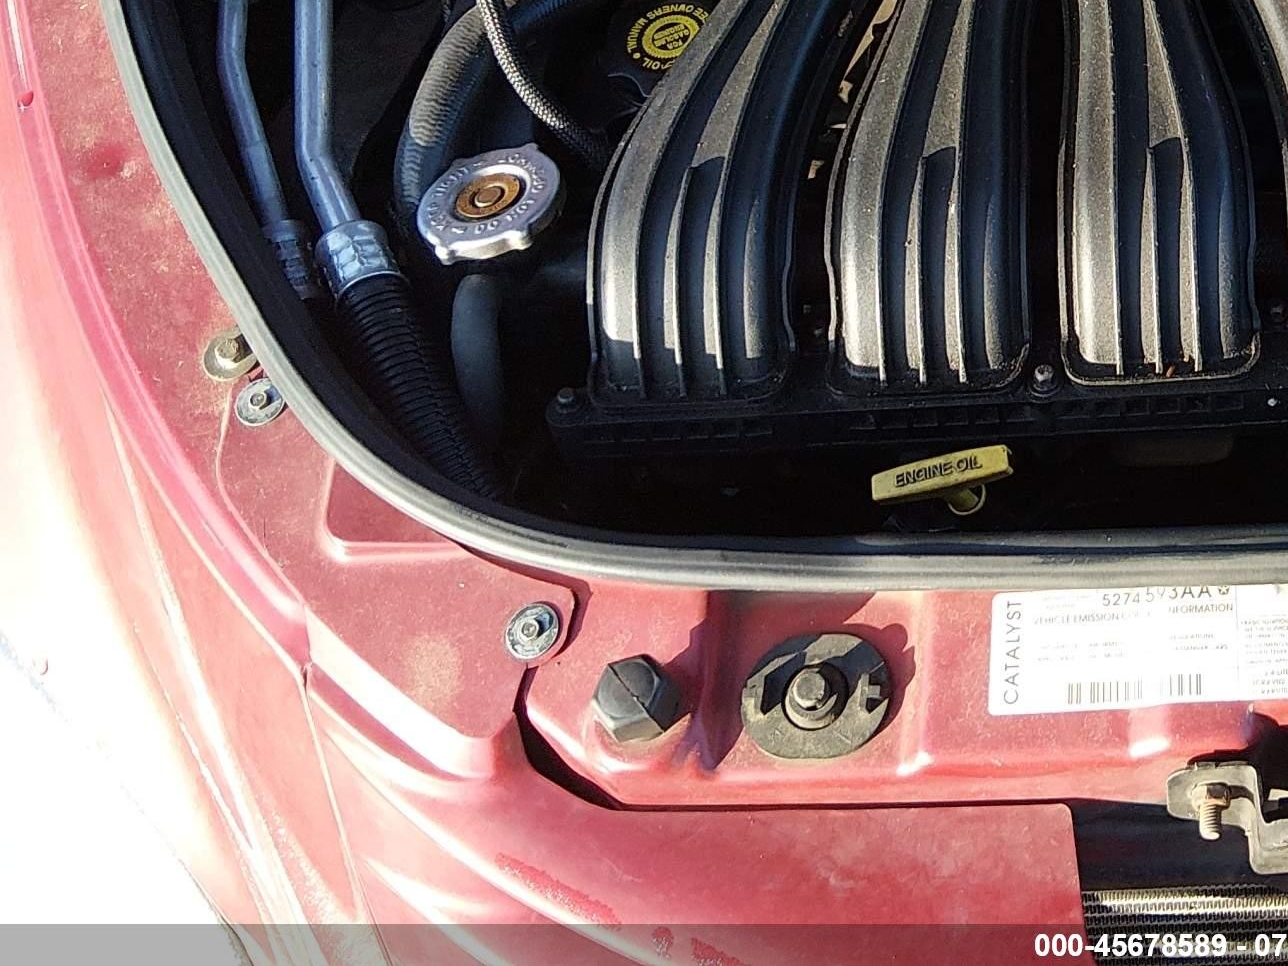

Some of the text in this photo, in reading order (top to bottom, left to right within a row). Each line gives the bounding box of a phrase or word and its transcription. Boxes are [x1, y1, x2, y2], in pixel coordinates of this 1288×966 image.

[646, 3, 695, 20] OWNERS
[626, 17, 648, 53] MANUAL
[642, 57, 660, 70] OIL
[895, 456, 983, 488] ENGINE OIL
[1073, 612, 1119, 624] EMISSION
[1003, 600, 1022, 705] CATALYST
